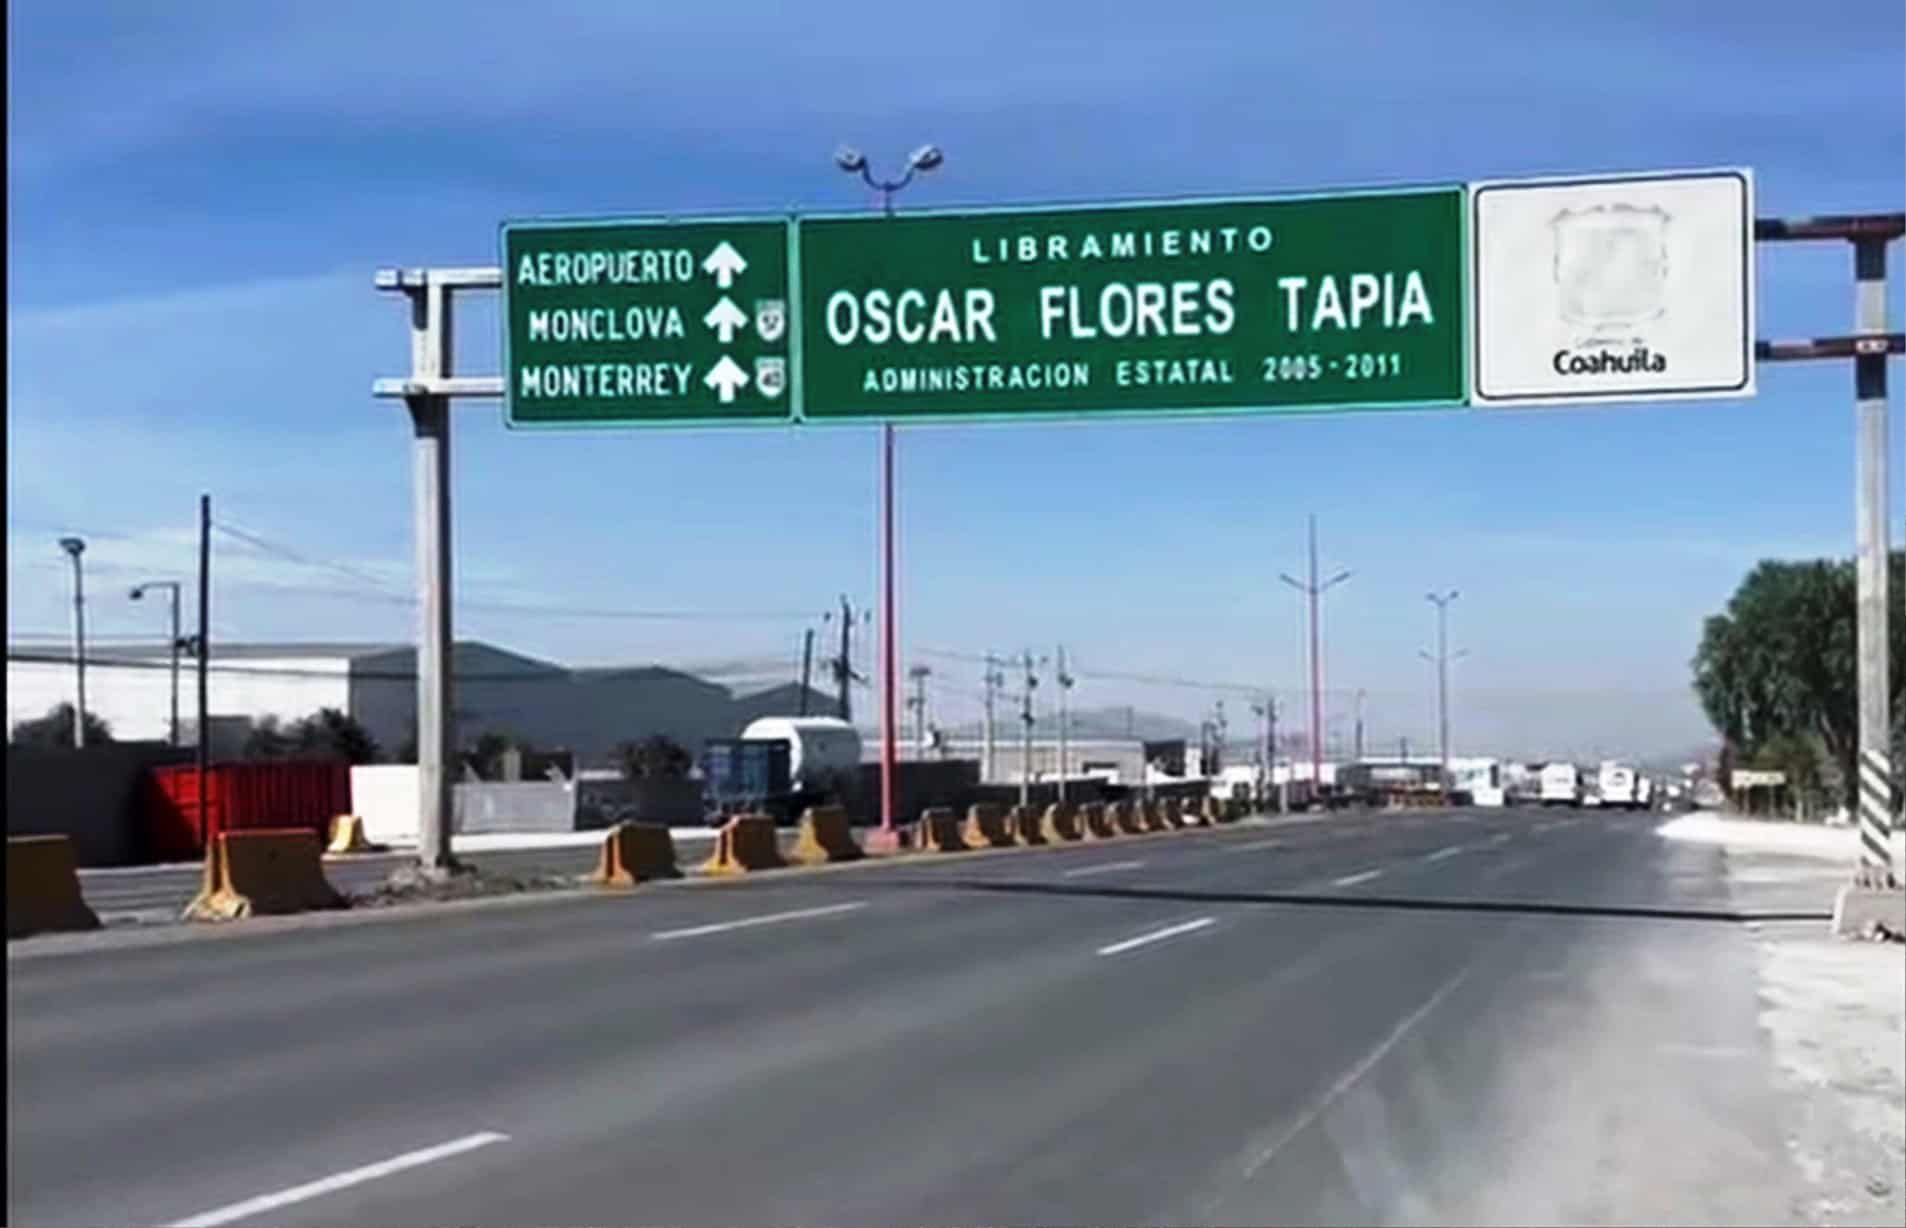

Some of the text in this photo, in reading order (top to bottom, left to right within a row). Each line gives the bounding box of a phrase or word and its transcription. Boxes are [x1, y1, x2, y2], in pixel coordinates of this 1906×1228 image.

[973, 226, 1272, 263] LIBRAMIENTO
[519, 250, 693, 285] AEROPUERTO
[529, 307, 684, 341] MONCLOVA
[826, 270, 1433, 345] OSCAR FLORES TAPIA
[1116, 359, 1233, 386] ESTATAL
[1553, 347, 1667, 375] Coahuila
[521, 363, 692, 397] MONTERREY
